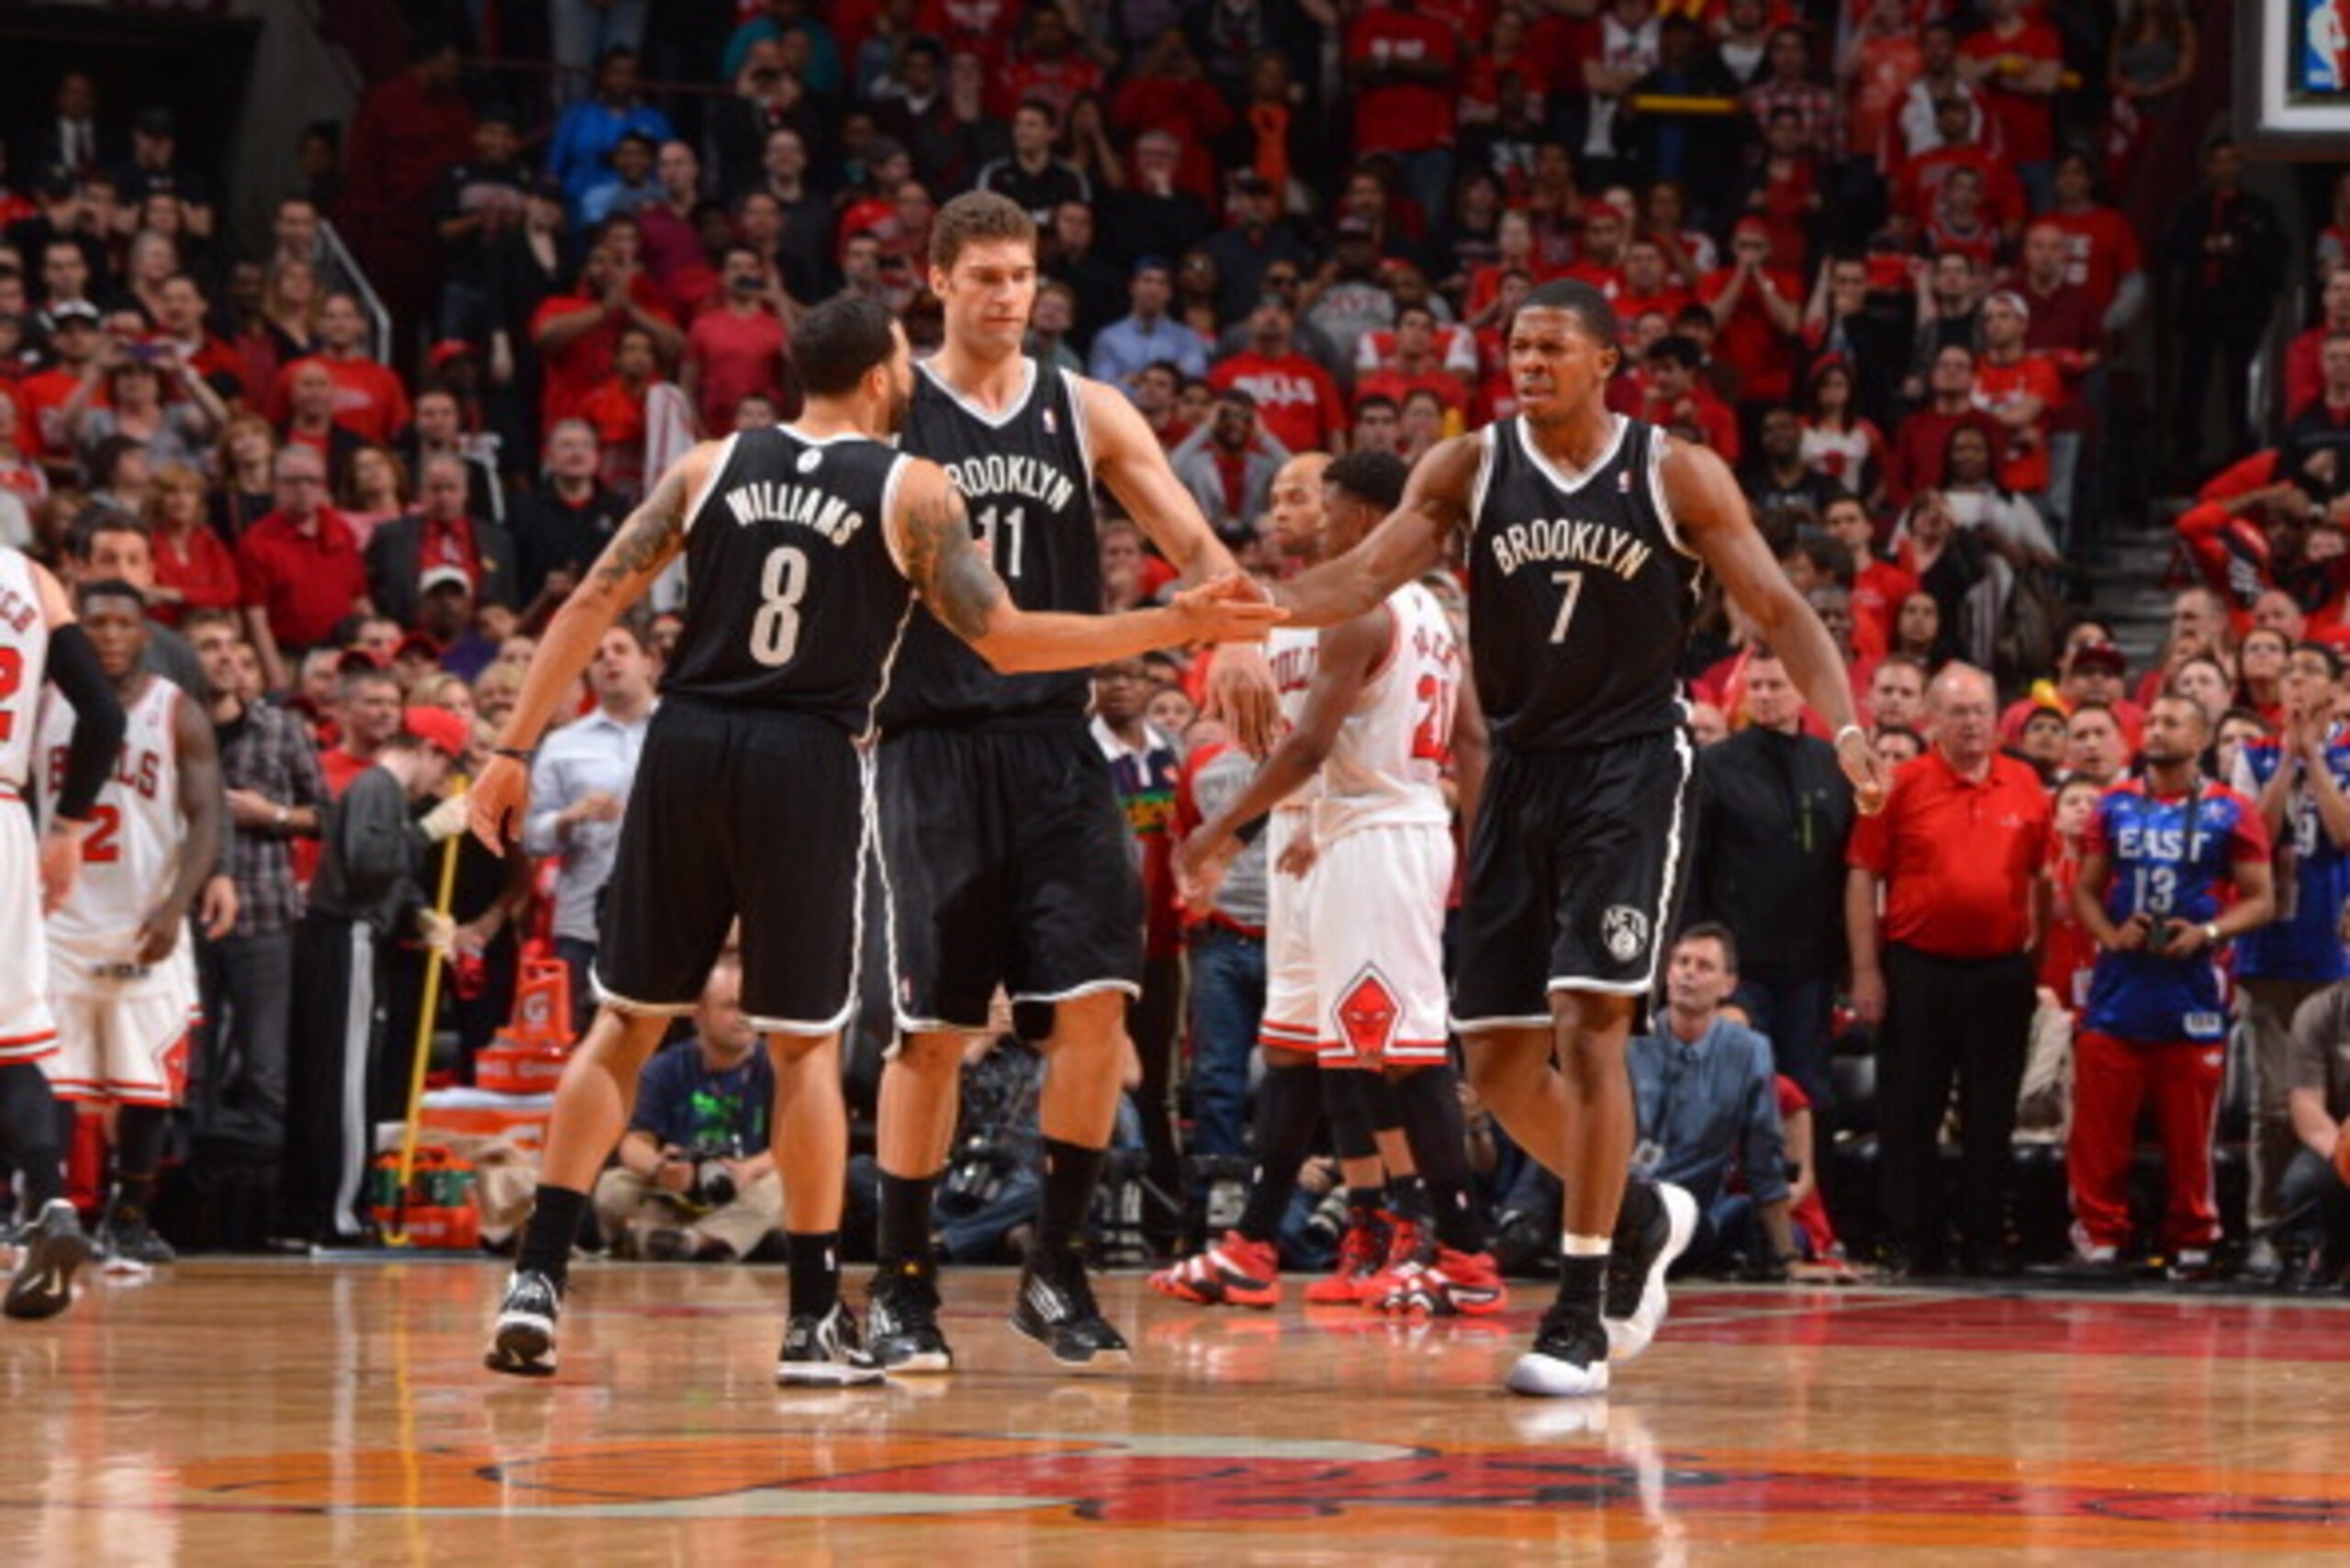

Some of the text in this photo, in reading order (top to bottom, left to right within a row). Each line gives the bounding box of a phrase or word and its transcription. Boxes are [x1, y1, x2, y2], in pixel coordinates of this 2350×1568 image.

[725, 480, 863, 546] WILLIAMS
[944, 454, 1074, 512] ROOKLYN
[978, 506, 1025, 577] 11
[1492, 519, 1651, 581] BROOKLYN
[749, 545, 808, 667] 8
[1550, 571, 1583, 644] 7
[81, 803, 120, 862] 2
[2119, 828, 2211, 862] EAST
[2134, 867, 2177, 914] 13
